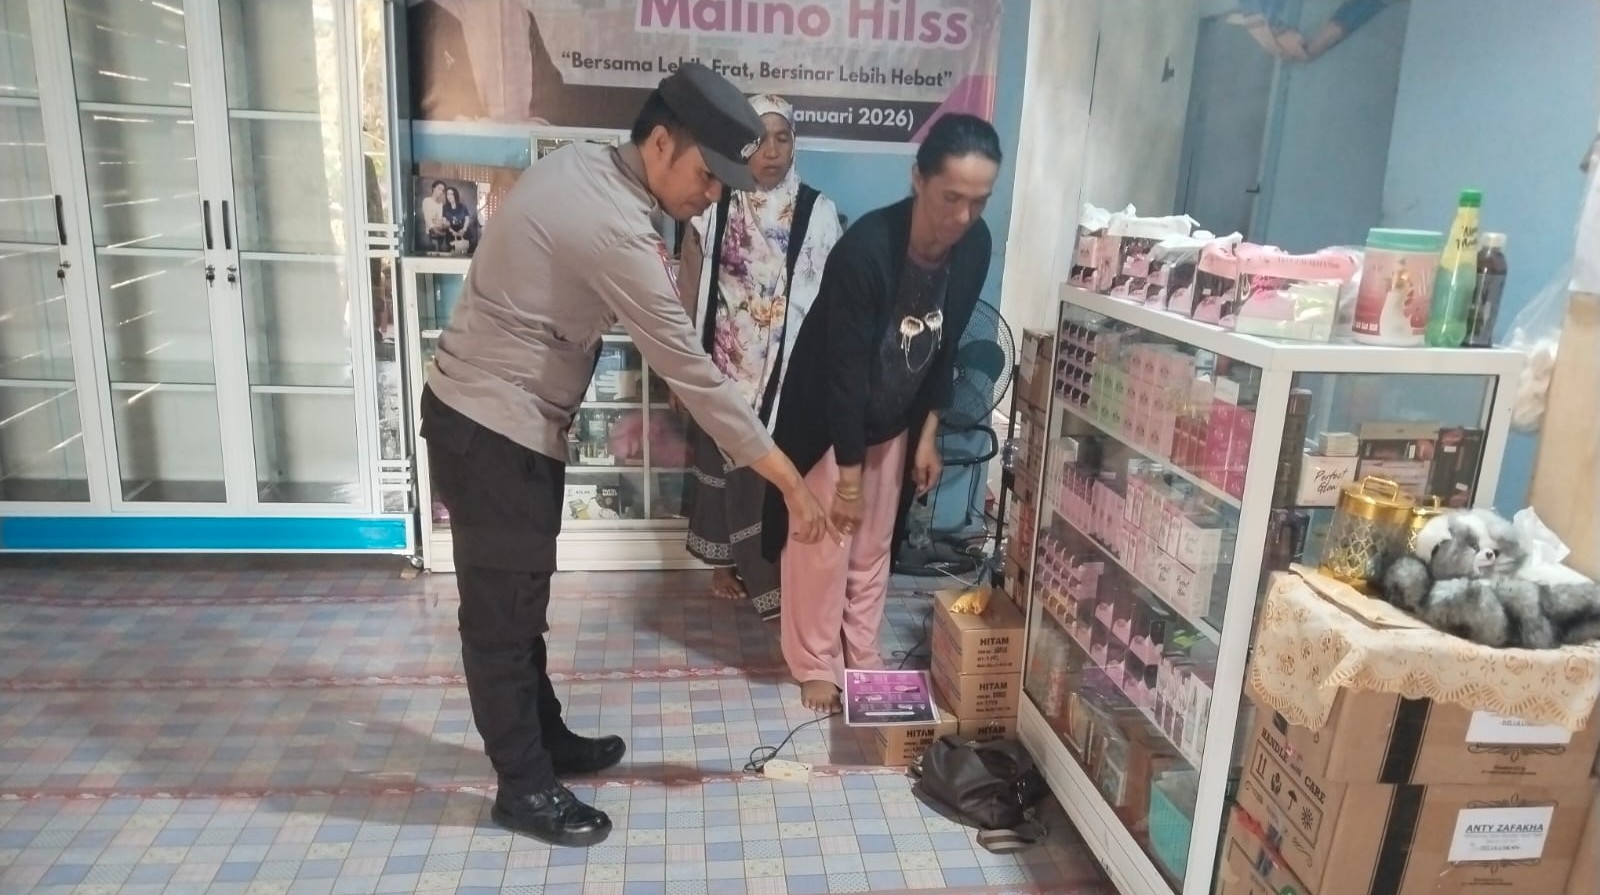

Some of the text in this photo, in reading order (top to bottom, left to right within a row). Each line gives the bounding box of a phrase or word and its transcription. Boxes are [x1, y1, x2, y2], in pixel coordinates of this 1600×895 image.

[640, 0, 968, 45] Malino Hilss
[760, 62, 834, 82] Bersinar
[839, 65, 886, 84] Lebih
[793, 106, 914, 131] anuari 2026)
[1313, 467, 1348, 483] Perfect
[980, 637, 1009, 646] HITAM
[979, 682, 1008, 691] HITAM
[906, 728, 935, 738] HITAM
[977, 725, 1006, 735] HITAM
[1304, 775, 1327, 805] CARE
[1465, 823, 1494, 833] ANTY
